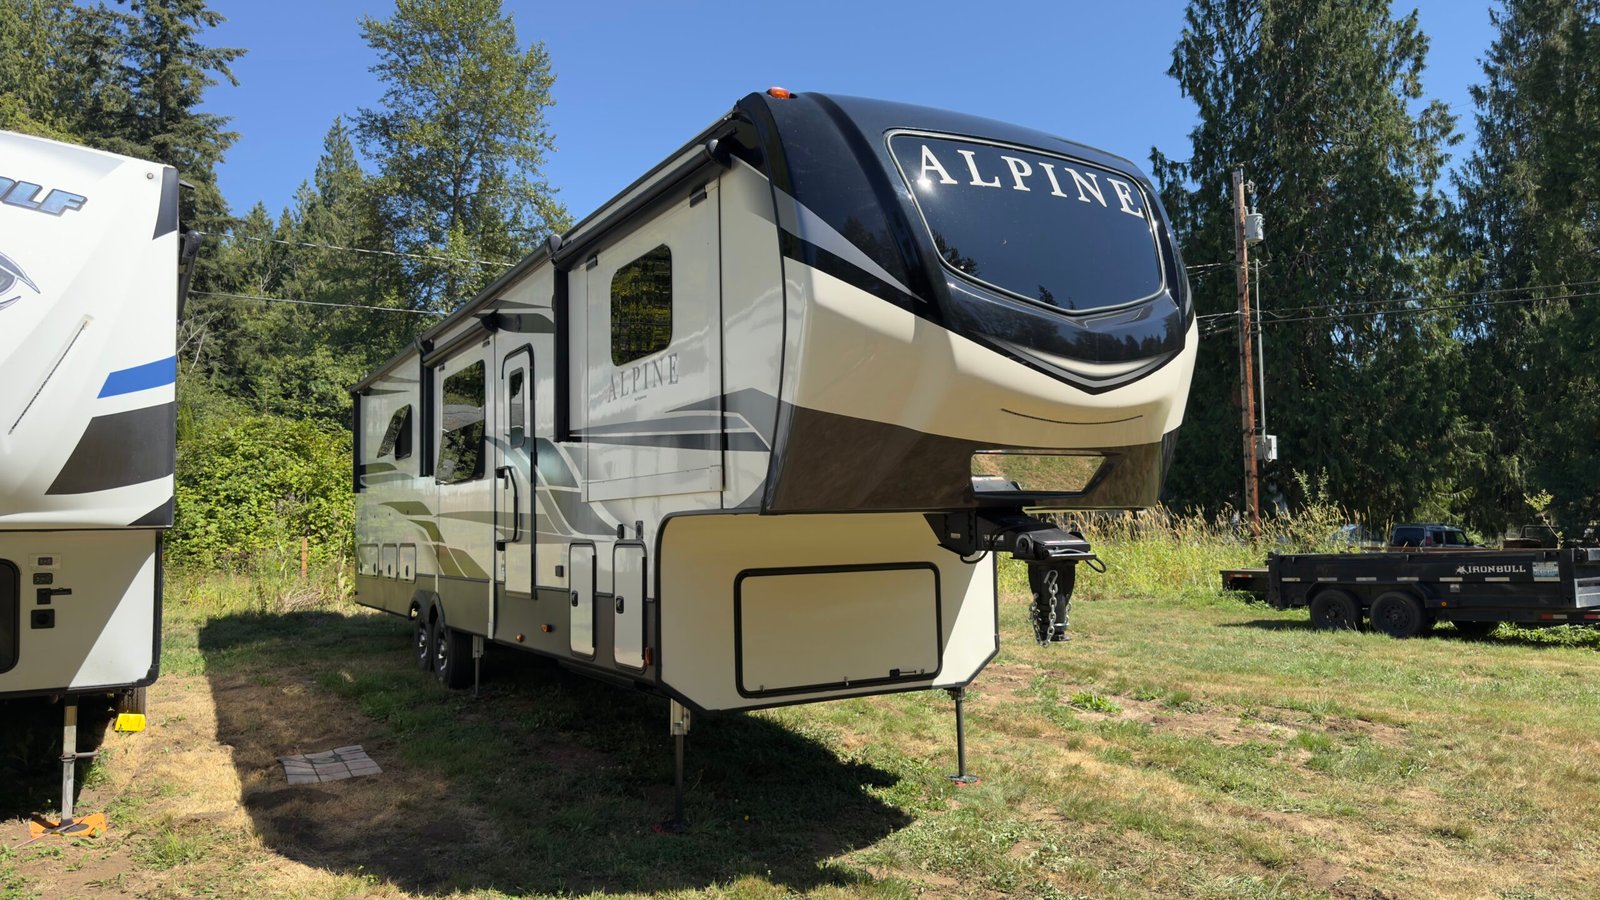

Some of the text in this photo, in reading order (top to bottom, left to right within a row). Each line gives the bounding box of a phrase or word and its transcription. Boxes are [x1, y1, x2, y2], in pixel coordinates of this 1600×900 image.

[917, 144, 1145, 218] ALPINE
[607, 352, 679, 403] ALPINE
[1468, 565, 1526, 573] IRONBULL
